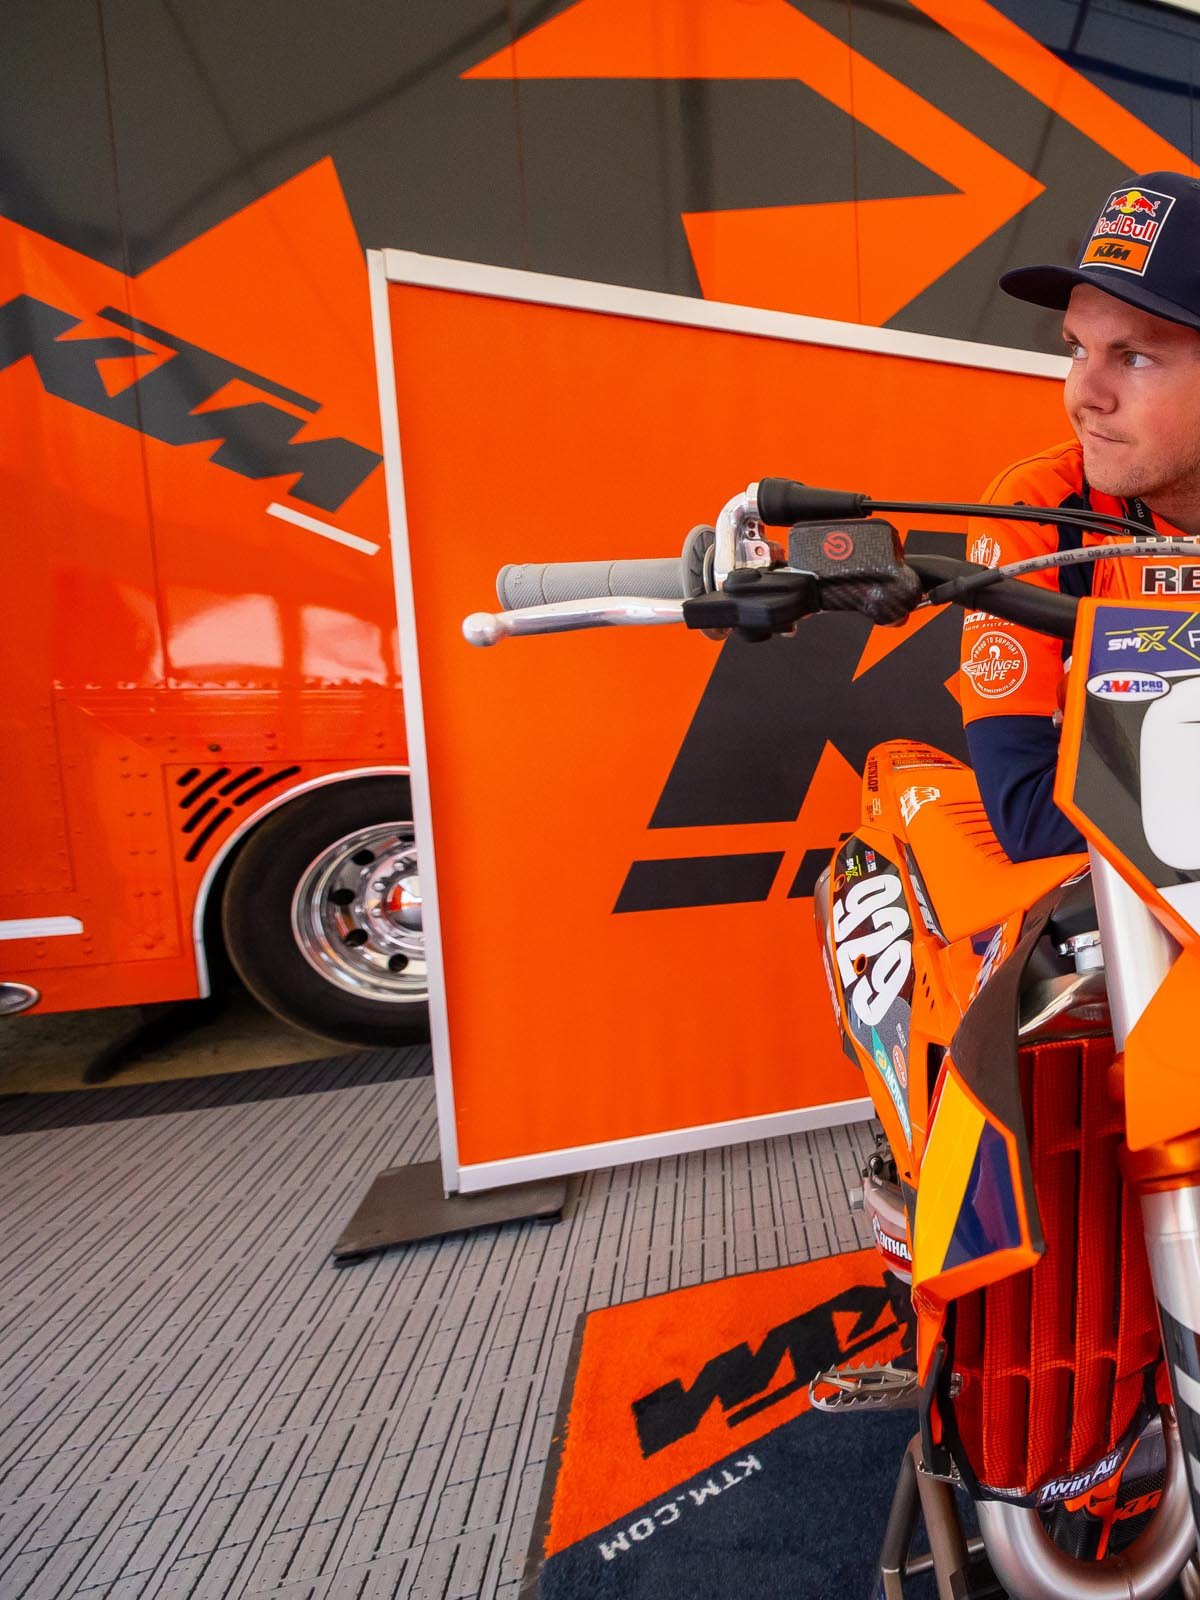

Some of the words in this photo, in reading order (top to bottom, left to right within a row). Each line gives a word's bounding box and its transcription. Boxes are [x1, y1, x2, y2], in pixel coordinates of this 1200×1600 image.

[1094, 215, 1122, 236] Red
[1119, 216, 1158, 242] Bull
[1094, 243, 1131, 261] KTM
[1107, 630, 1167, 653] SMX
[1095, 680, 1141, 693] AMA
[1141, 680, 1164, 689] PRO
[867, 760, 879, 792] DUNLOP
[833, 874, 911, 1026] 929
[1041, 1474, 1091, 1500] Twin
[1092, 1453, 1120, 1480] Air
[599, 1454, 762, 1560] KTM.COM
